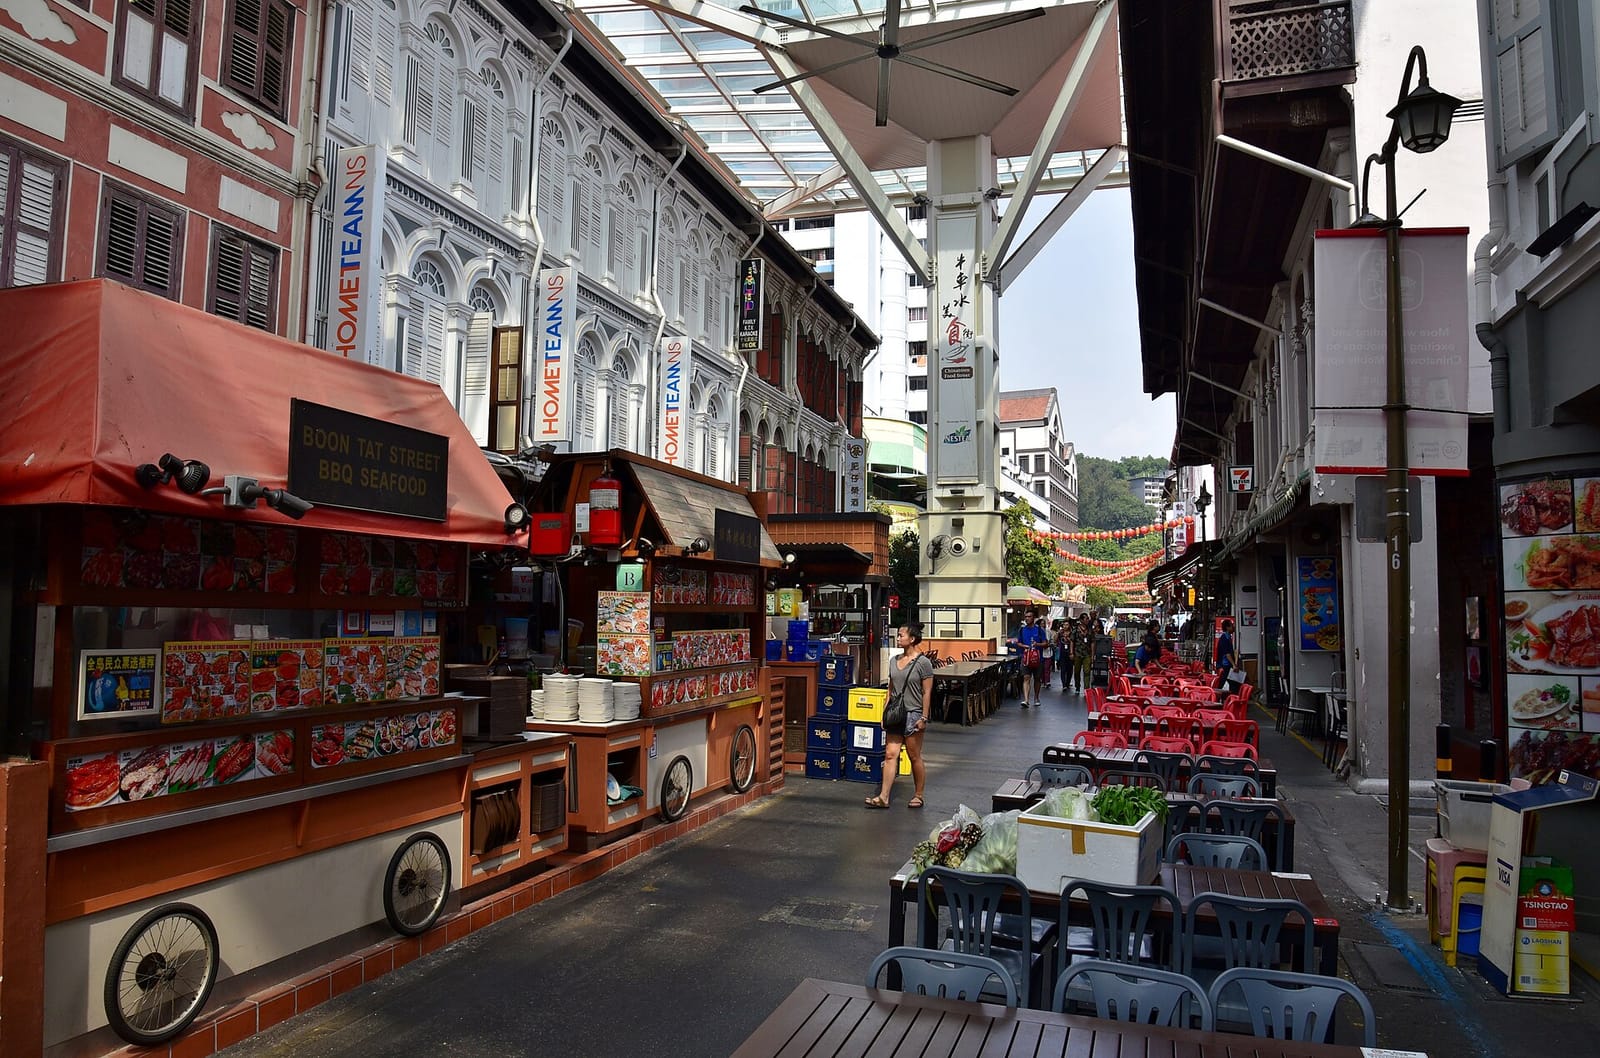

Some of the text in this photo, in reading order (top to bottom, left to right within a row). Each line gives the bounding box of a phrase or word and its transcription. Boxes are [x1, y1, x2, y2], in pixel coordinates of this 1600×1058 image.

[542, 275, 564, 435] HOMETEAMNS
[303, 425, 441, 473] BOON TAT STREET
[319, 459, 427, 496] BBQ SEAFOOD
[624, 572, 635, 586] B
[1497, 867, 1512, 887] VISA
[1523, 901, 1569, 911] TSINGTAO
[1531, 937, 1562, 945] LAOSHAN
